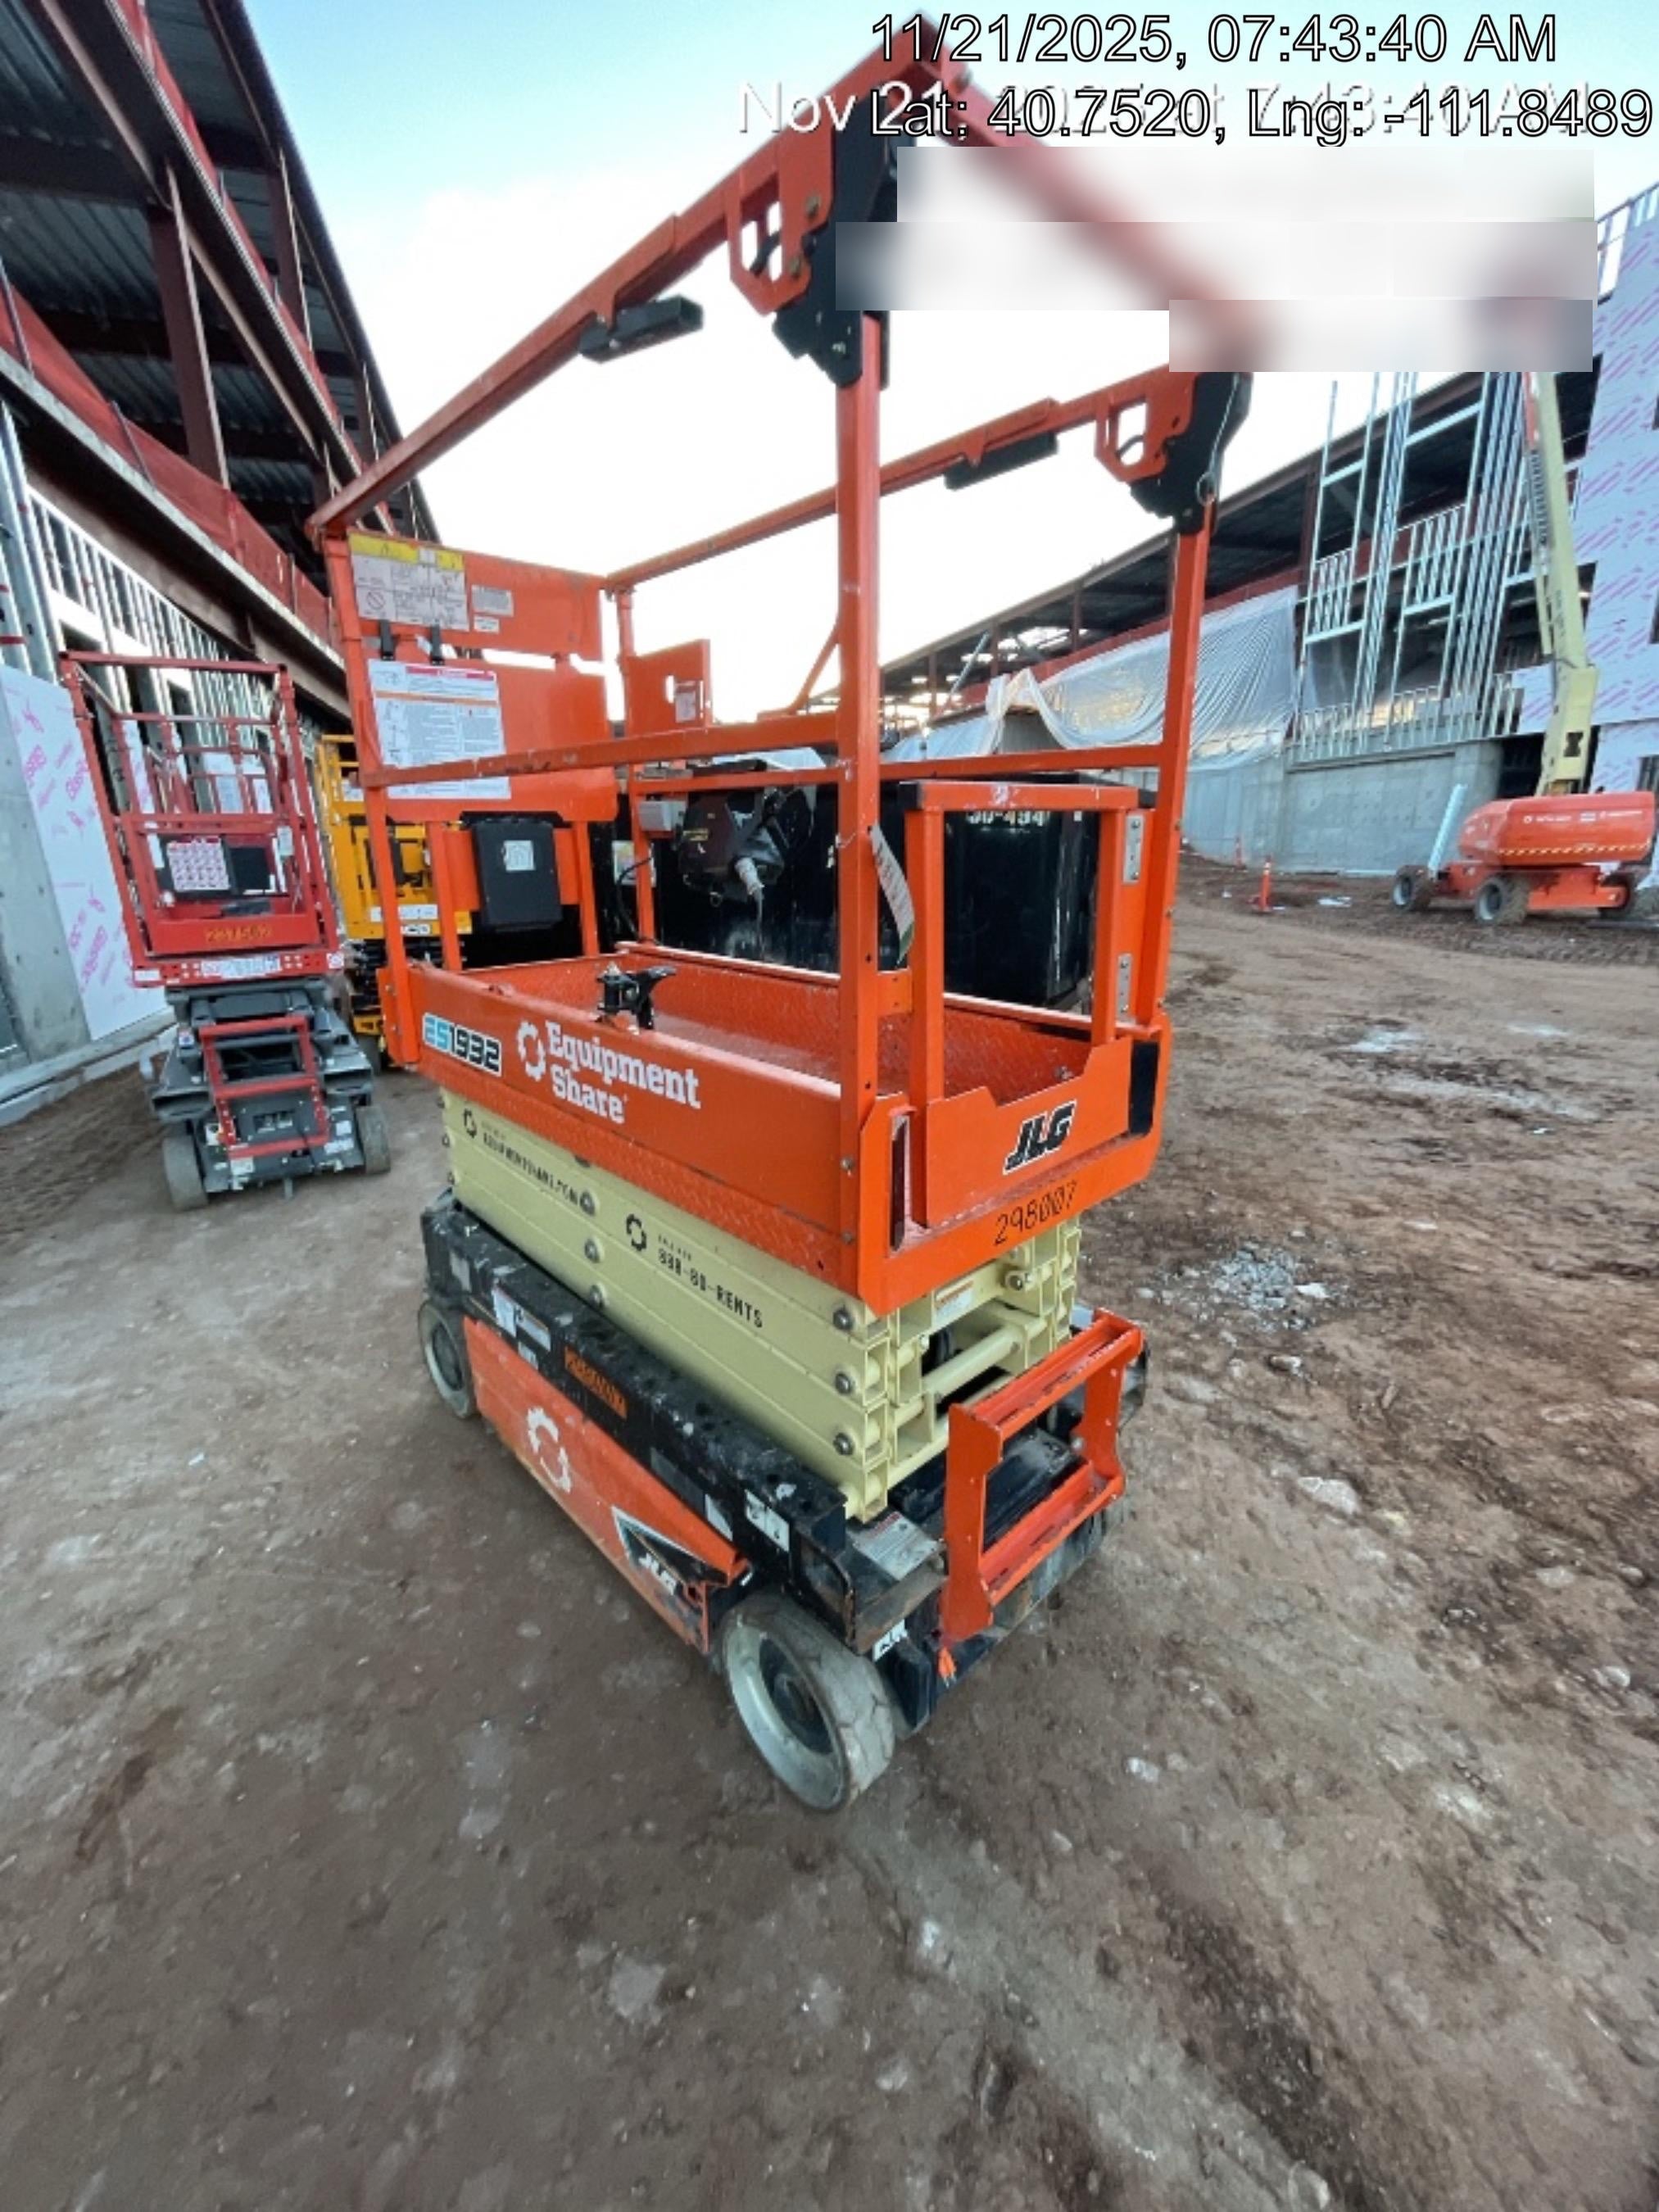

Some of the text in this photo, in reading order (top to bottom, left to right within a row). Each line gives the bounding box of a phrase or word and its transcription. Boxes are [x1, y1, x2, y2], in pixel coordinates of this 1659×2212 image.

[424, 1016, 501, 1074] ES1932
[545, 1020, 701, 1109] Equipment
[551, 1064, 626, 1124] Share
[1002, 1099, 1077, 1175] JLG
[994, 1180, 1078, 1247] 298007
